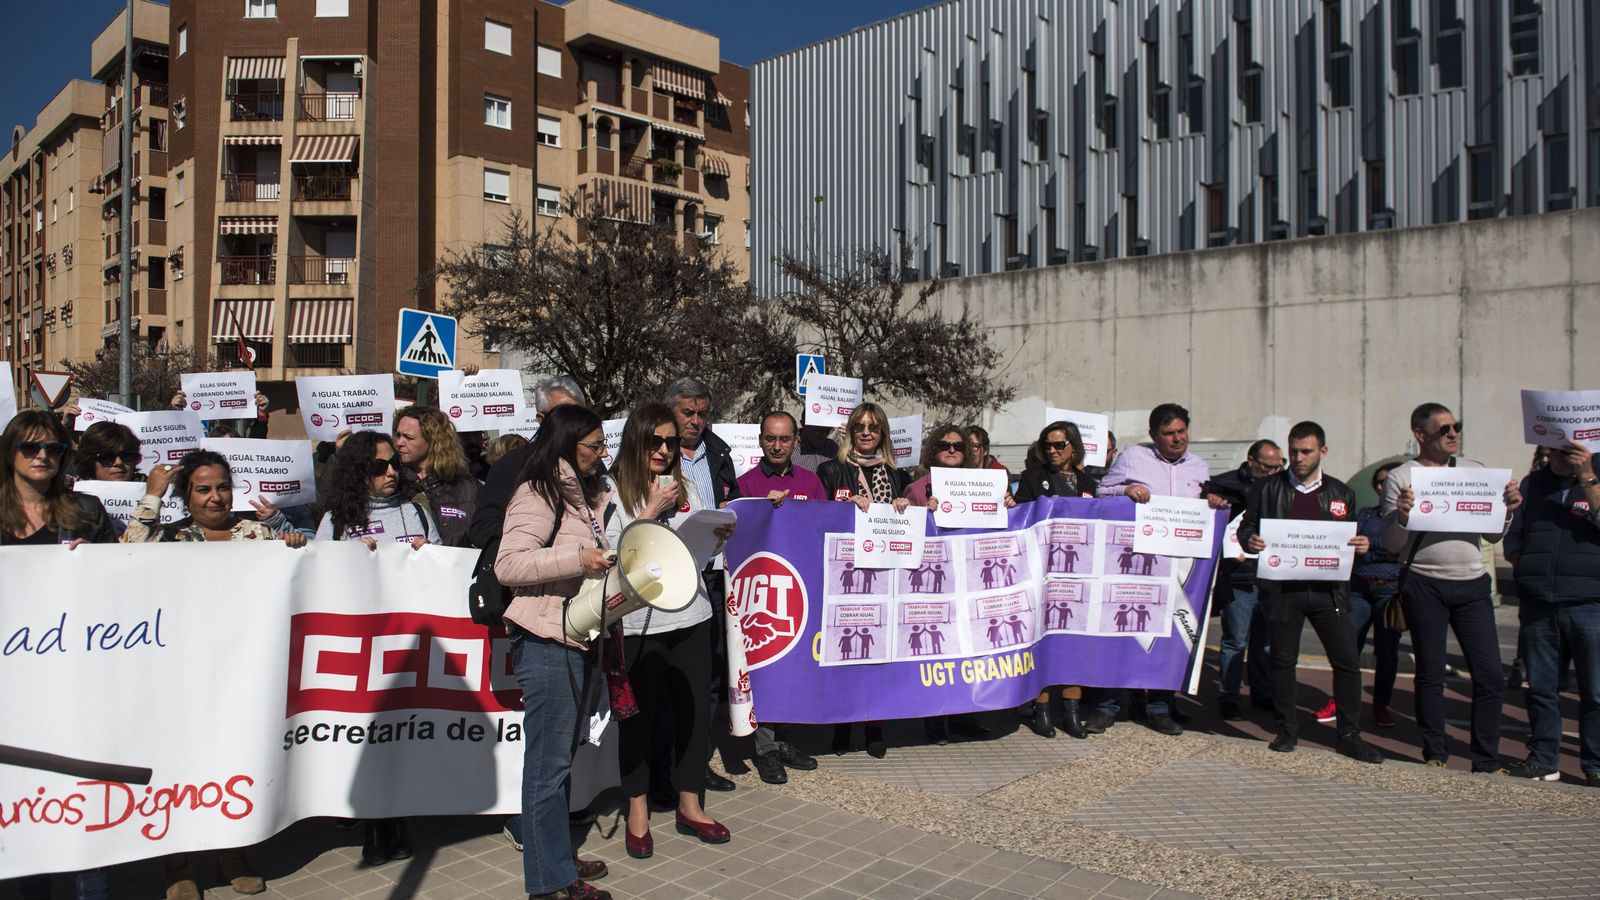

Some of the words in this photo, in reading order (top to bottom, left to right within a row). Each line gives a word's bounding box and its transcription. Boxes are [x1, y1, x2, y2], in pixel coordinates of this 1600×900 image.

[255, 455, 294, 463] TRABAJO,
[732, 574, 794, 636] UGT
[86, 608, 166, 652] real
[920, 662, 956, 687] UGT
[961, 652, 1034, 684] GRANADA
[283, 715, 434, 751] secretaría
[447, 718, 485, 742] de
[497, 718, 521, 742] la
